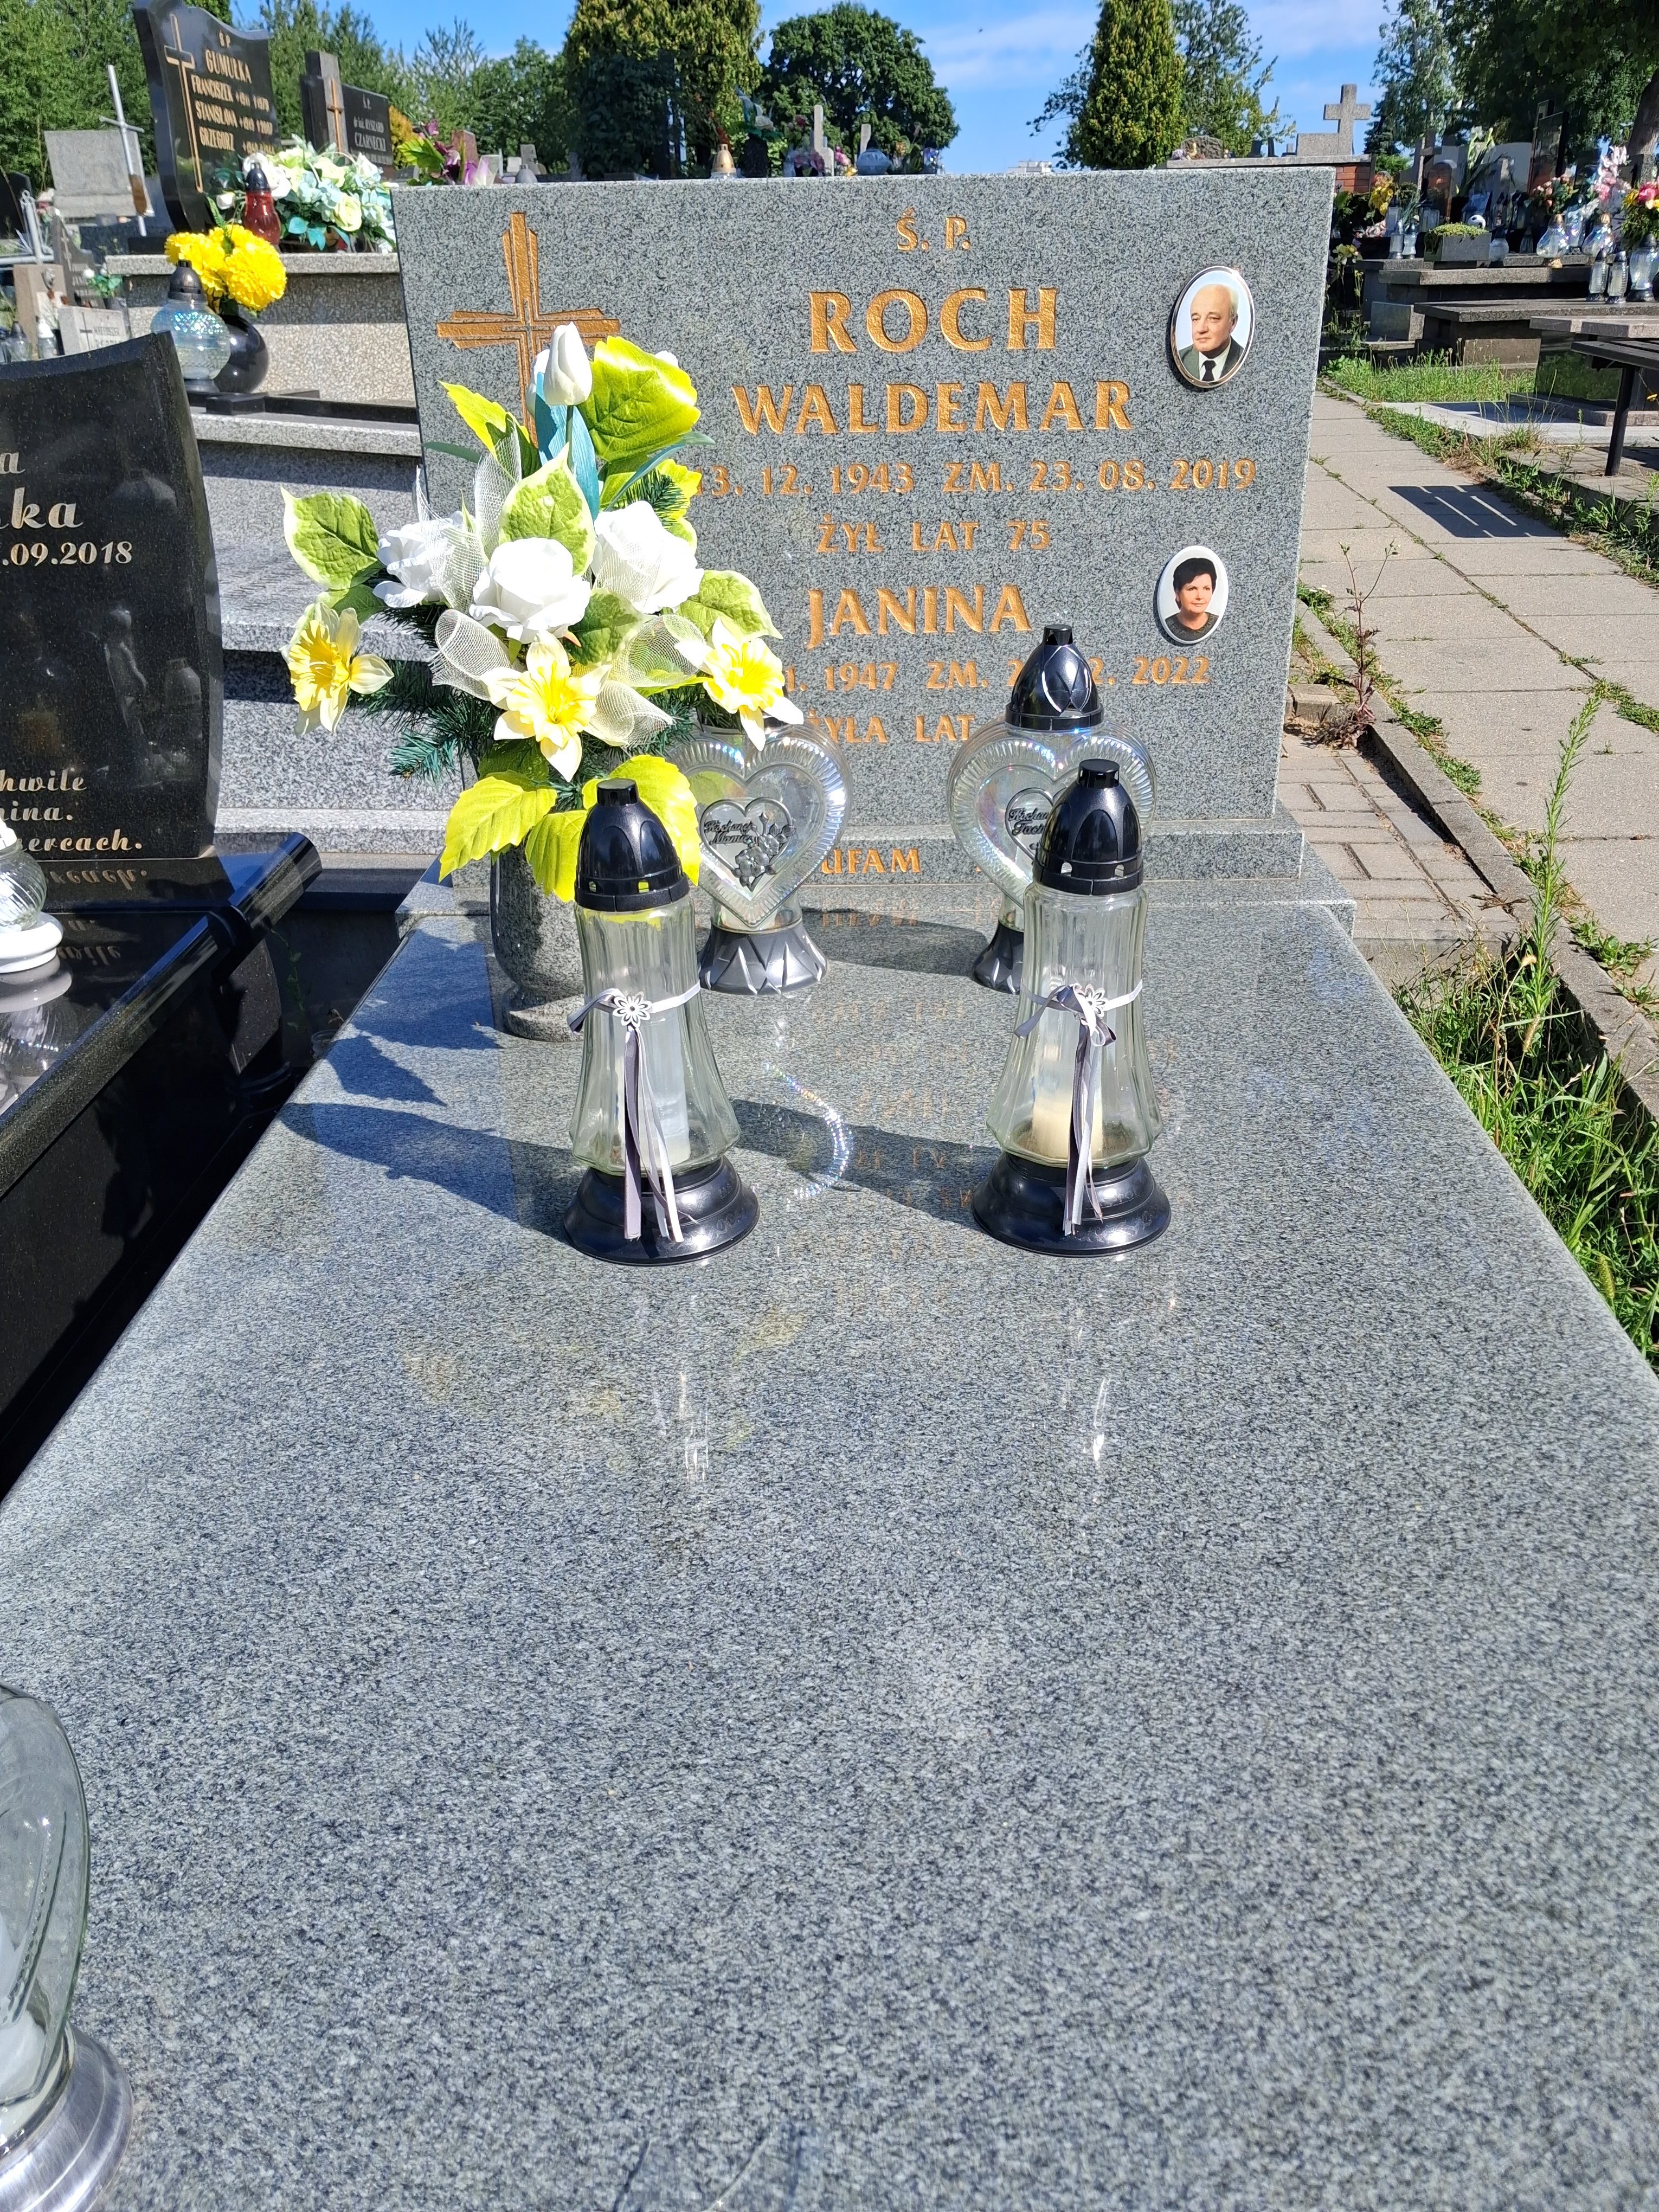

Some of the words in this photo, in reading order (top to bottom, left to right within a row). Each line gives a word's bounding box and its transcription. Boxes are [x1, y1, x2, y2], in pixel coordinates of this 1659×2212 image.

[205, 49, 252, 83] GUMUŁKA
[191, 74, 234, 102] FRANCISZEK
[199, 126, 235, 152] GRZEGORZ
[354, 132, 387, 152] CZARNECKI
[896, 207, 929, 252] Ś.
[944, 216, 972, 252] P.
[809, 287, 1058, 353] ROCH
[731, 380, 1134, 435] WALDEMAR
[761, 464, 813, 496] 12.
[829, 462, 915, 494] 1943
[942, 461, 1013, 493] ZM.
[1030, 460, 1083, 491] 23.
[1098, 459, 1155, 491] 08.
[1170, 457, 1257, 490] 2019
[816, 513, 884, 554] ŻYŁ
[912, 520, 979, 552] LAT
[1007, 519, 1051, 551] 75
[806, 583, 1033, 650] JANINA
[824, 661, 899, 692] 1947
[926, 660, 989, 689] ZM.
[1131, 654, 1211, 685] 2022
[915, 714, 975, 742] LAT
[820, 847, 922, 875] UFAM
